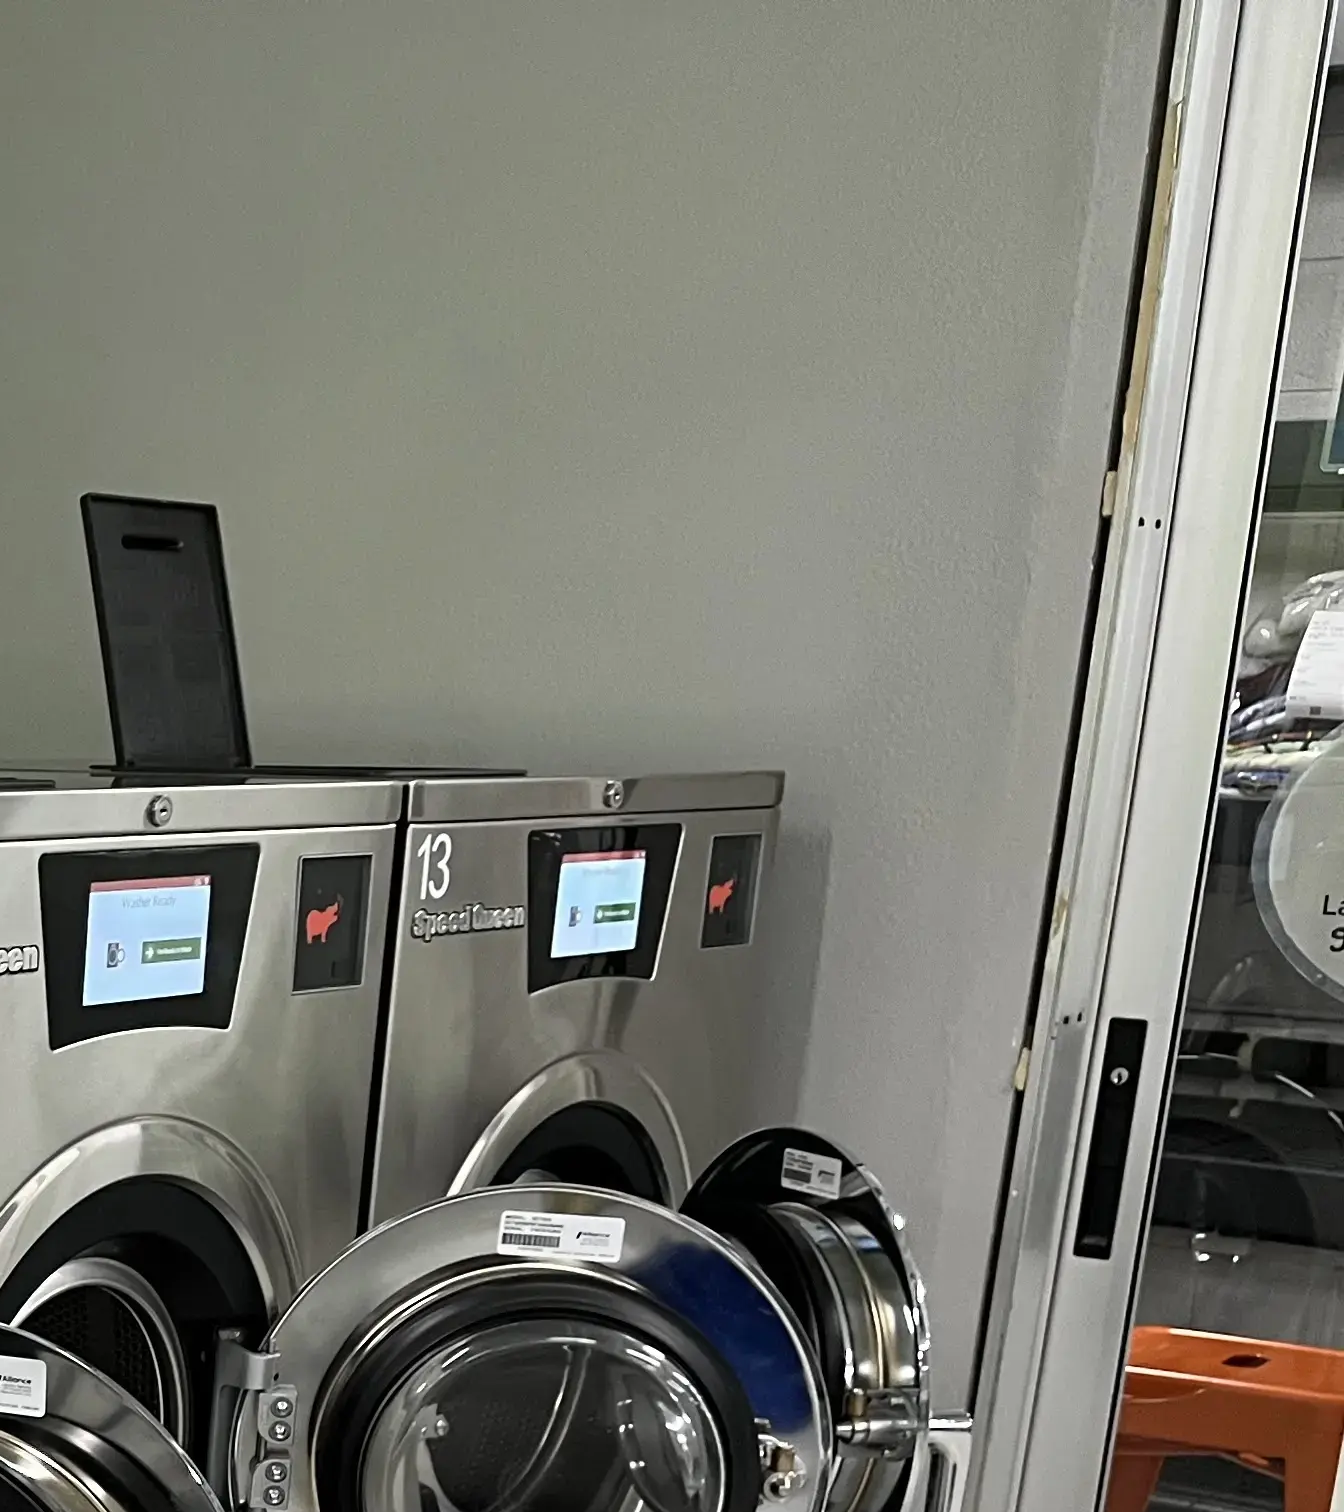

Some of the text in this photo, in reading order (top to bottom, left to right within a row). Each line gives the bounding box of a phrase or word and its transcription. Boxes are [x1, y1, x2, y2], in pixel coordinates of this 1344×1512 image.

[417, 832, 452, 901] 13
[411, 901, 525, 943] Speed Queen
